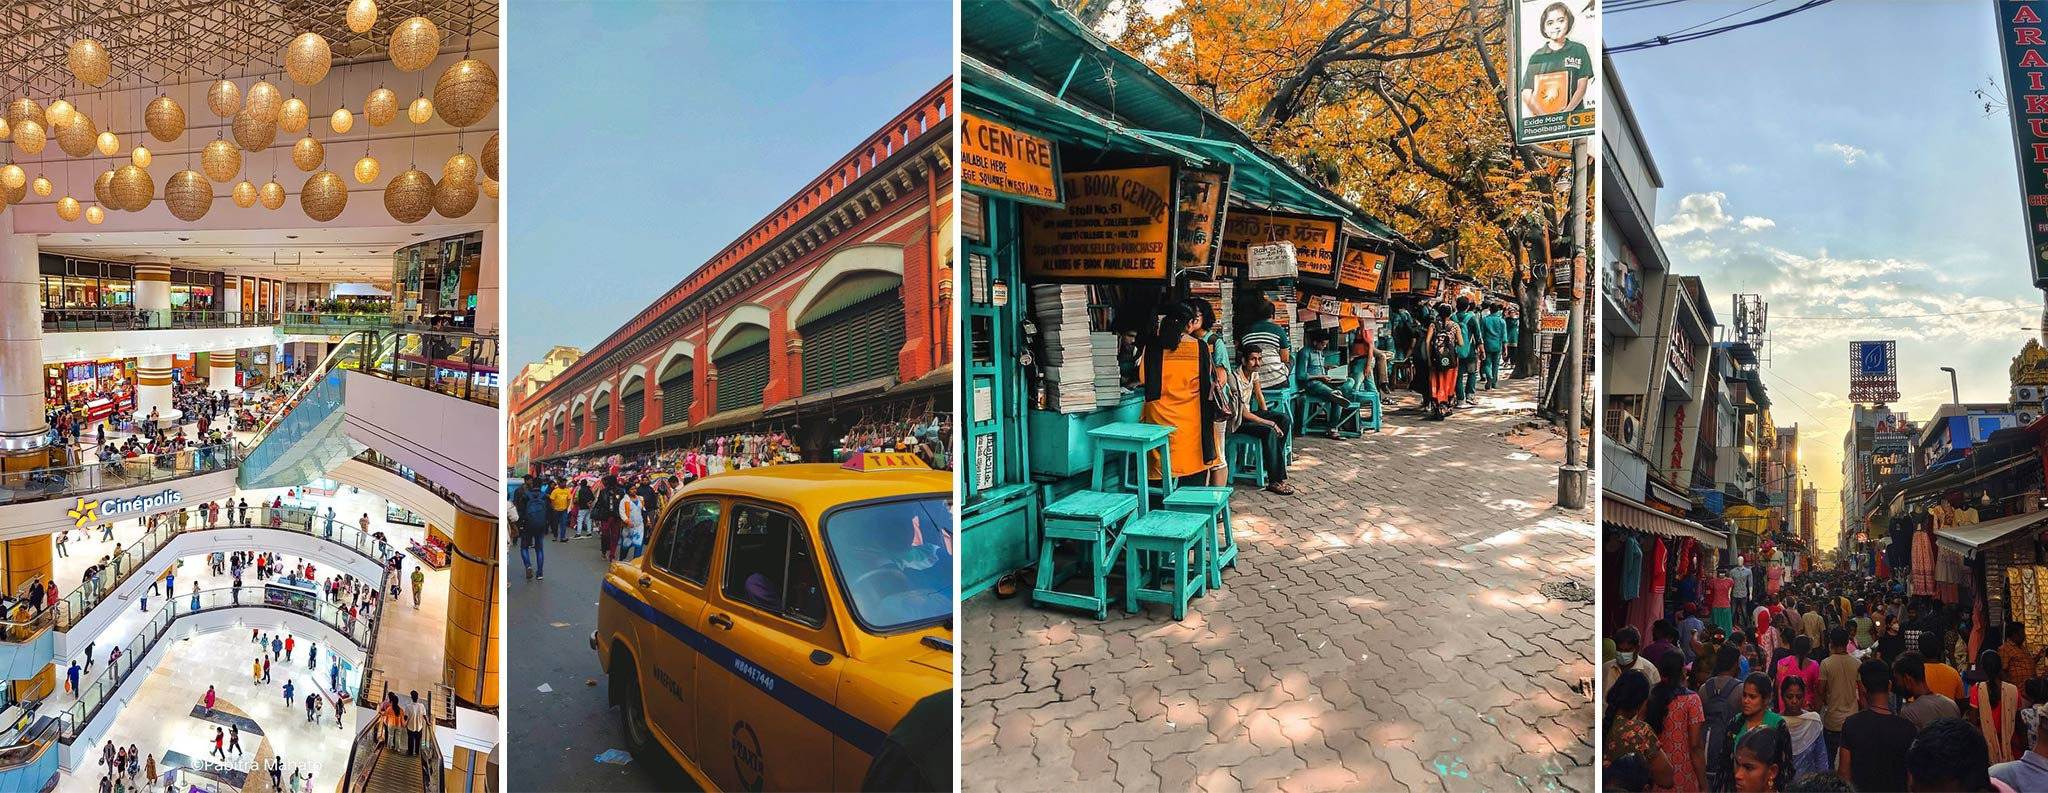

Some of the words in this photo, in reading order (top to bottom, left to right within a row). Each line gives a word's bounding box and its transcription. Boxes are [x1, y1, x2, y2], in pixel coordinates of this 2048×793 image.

[1524, 118, 1543, 126] Exide
[1524, 124, 1566, 134] Phoolbagan
[978, 125, 1051, 168] CENTRE
[990, 159, 1007, 173] HERE
[979, 172, 1004, 187] SQUARE
[1084, 175, 1119, 197] BOOK
[1122, 178, 1170, 223] CENTRE
[2028, 194, 2048, 206] CHE
[1121, 242, 1163, 254] PURCHASER
[1104, 258, 1138, 270] AVAILABLE
[1140, 258, 1155, 269] HERE
[870, 455, 918, 466] TAXI
[1872, 452, 1907, 465] Textile
[1880, 465, 1910, 475] india
[101, 489, 181, 515] Cinépolis
[734, 658, 775, 691] WB04E7440
